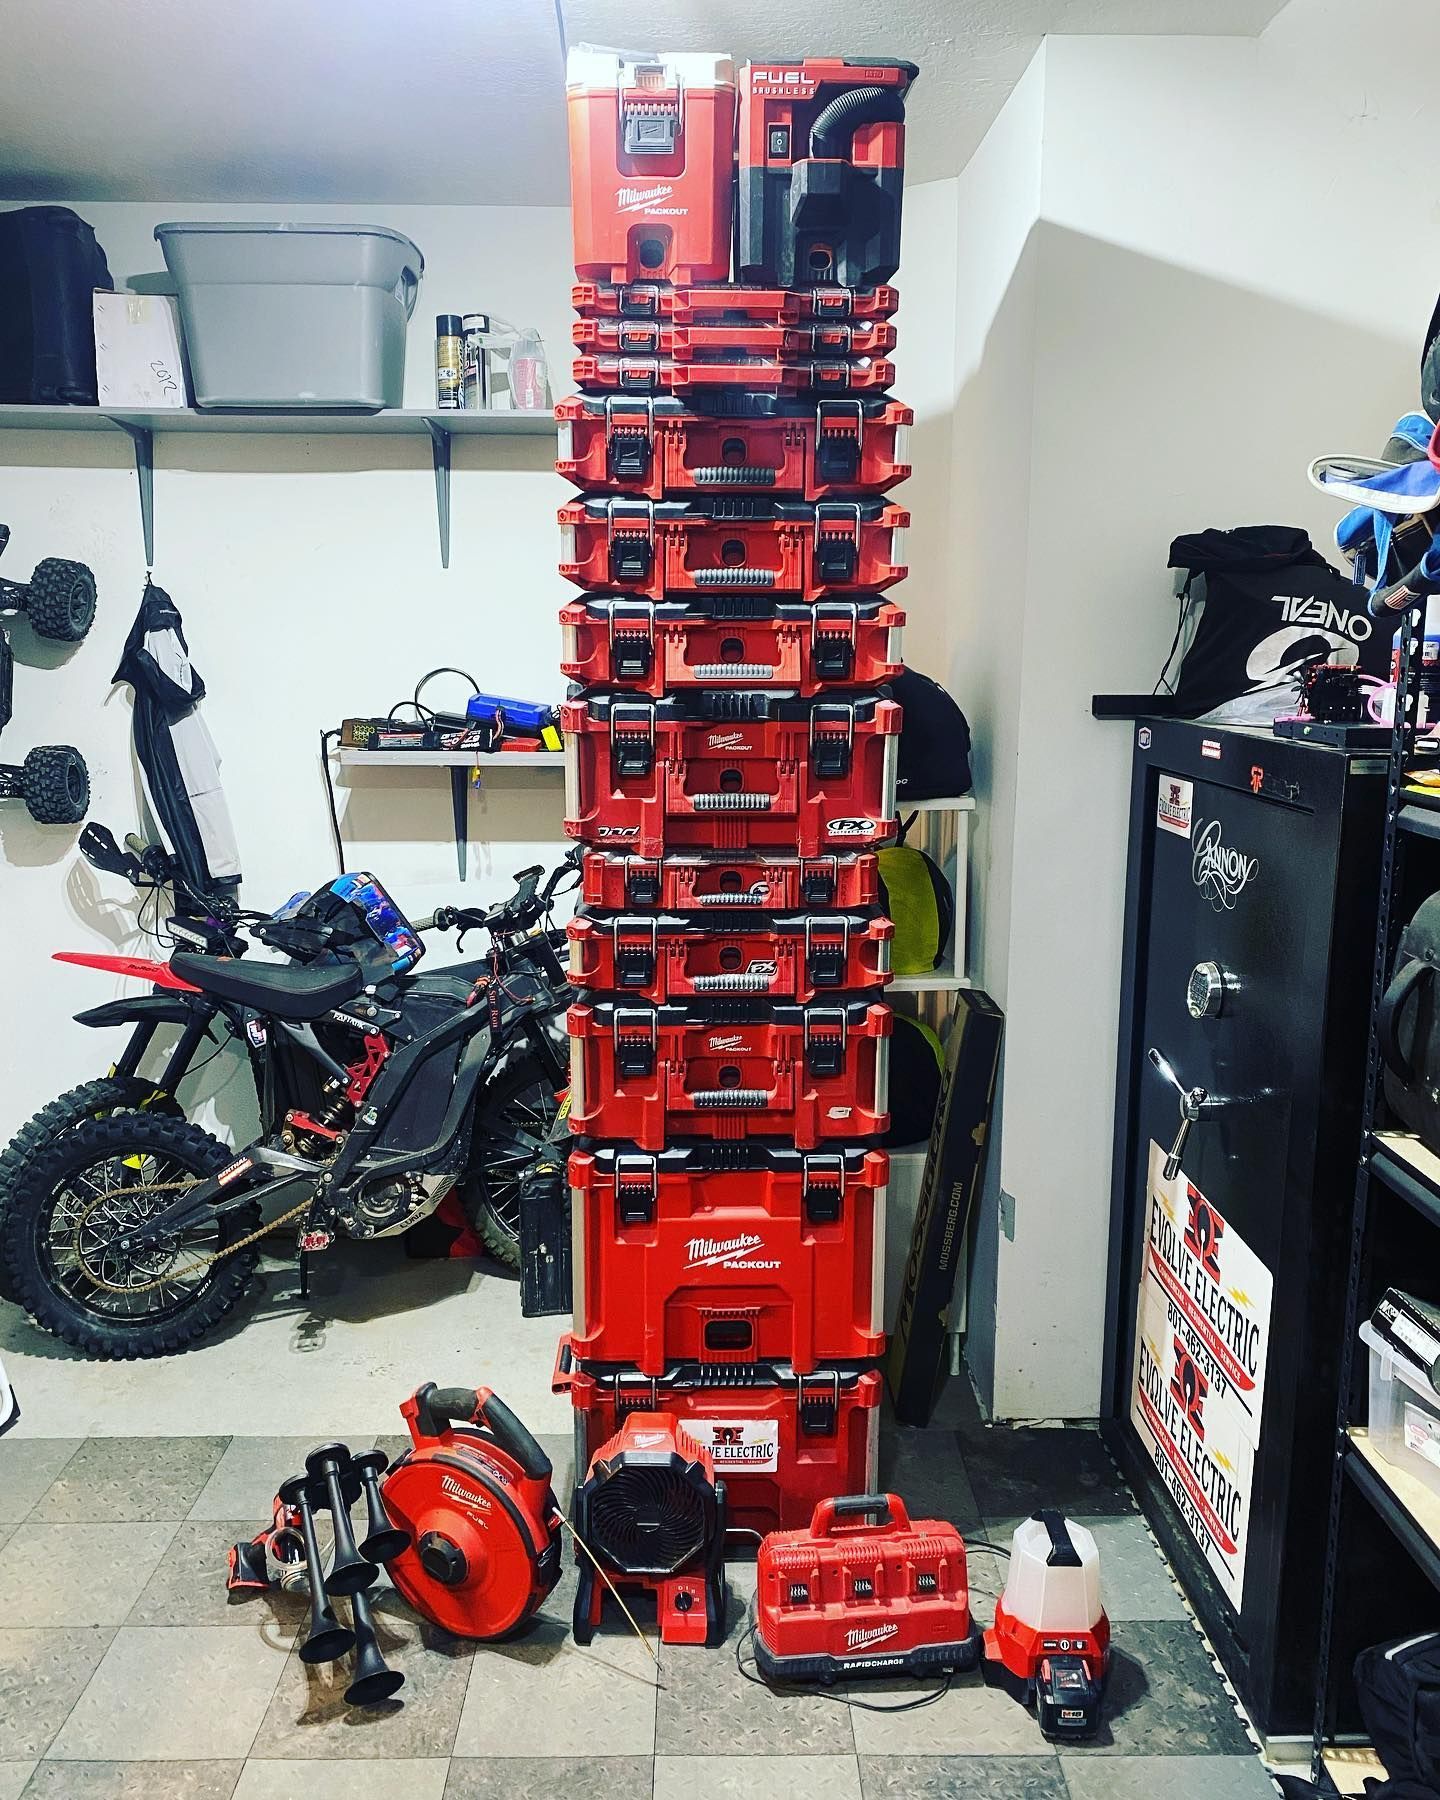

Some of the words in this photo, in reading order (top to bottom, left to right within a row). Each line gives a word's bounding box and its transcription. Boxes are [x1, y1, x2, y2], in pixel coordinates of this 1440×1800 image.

[752, 71, 815, 85] FUEL
[752, 87, 816, 96] BRUSHLESS
[615, 184, 673, 208] Milwaukee
[707, 731, 744, 747] Milwaukee
[708, 1034, 743, 1048] Milwaukee
[938, 1181, 964, 1271] MOSSBERG.COM
[684, 1233, 762, 1261] Milwaukee
[723, 1260, 782, 1269] PACKOUT
[1194, 1266, 1260, 1378] ELECTRIC
[1168, 1302, 1227, 1399] 801-462-3137
[1188, 1301, 1217, 1348] RESIDENTIAL
[1219, 1347, 1241, 1384] SERVICE
[724, 1443, 774, 1458] ELECTRIC
[441, 1475, 492, 1509] Milwaukee
[1180, 1418, 1241, 1543] ELECTRIC
[1154, 1446, 1211, 1556] 801-462-3137
[466, 1511, 489, 1530] FUEL
[844, 1623, 899, 1646] Milwaukee
[843, 1658, 905, 1670] RAPIDCHARGE
